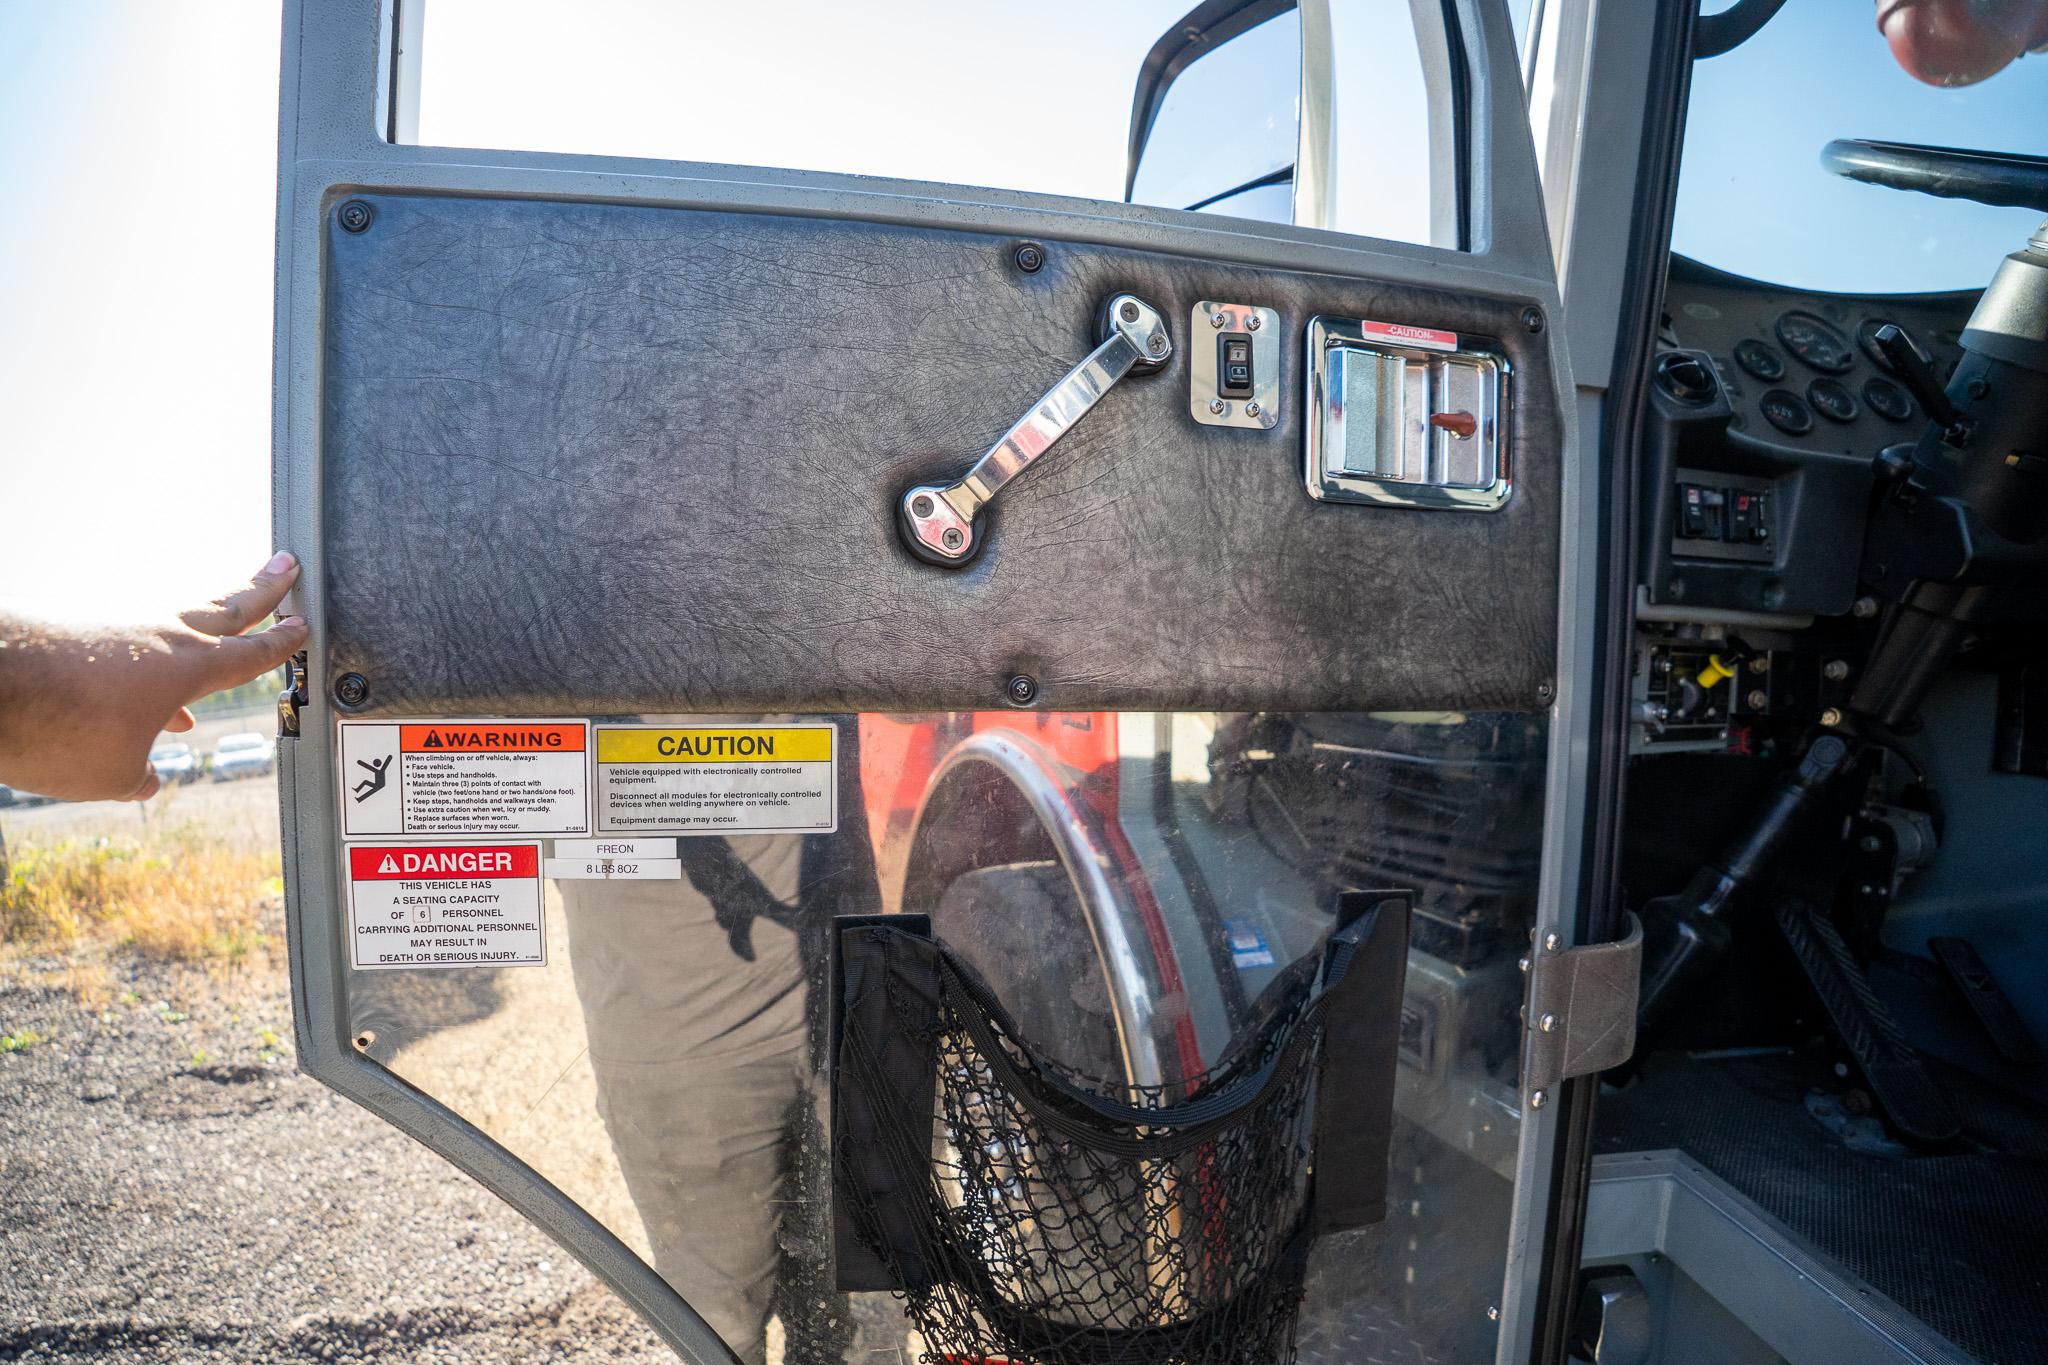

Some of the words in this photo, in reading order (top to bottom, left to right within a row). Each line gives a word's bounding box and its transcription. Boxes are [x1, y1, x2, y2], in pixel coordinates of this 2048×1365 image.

[445, 732, 562, 747] WARNING
[657, 736, 774, 756] CAUTION
[486, 754, 512, 762] vehicle,
[513, 754, 538, 762] always:
[609, 768, 641, 776] Vehicle
[641, 768, 681, 777] equipped
[703, 768, 759, 776] electronically
[760, 767, 802, 775] controlled
[460, 780, 470, 788] (3)
[471, 780, 492, 788] points
[609, 777, 657, 785] equipment.
[558, 788, 576, 796] foot).
[610, 792, 658, 800] Disconnect
[723, 791, 779, 800] electronically
[780, 791, 822, 800] controlled
[503, 797, 536, 805] walkways
[644, 800, 667, 808] when
[669, 800, 702, 809] welding
[704, 800, 744, 809] anywhere
[758, 798, 790, 806] vehicle.
[610, 816, 656, 825] Equipment
[657, 817, 691, 825] damage
[463, 823, 483, 831] injury
[596, 844, 634, 854] FREON
[403, 852, 513, 873] DANGER
[586, 864, 593, 874] 8
[595, 864, 615, 874] LBS
[399, 882, 423, 890] THIS
[424, 881, 468, 890] VEHICLE
[470, 880, 492, 889] HAS
[393, 897, 400, 905] A
[402, 896, 447, 905] SEATING
[449, 895, 500, 904] CAPACITY
[390, 911, 405, 920] OF
[420, 910, 426, 919] 6
[442, 909, 504, 918] PERSONNEL
[358, 925, 411, 934] CARRYING
[413, 924, 474, 933] ADDITIONAL
[476, 923, 538, 932] PERSONNEL
[410, 939, 432, 947] MAY
[435, 938, 475, 947] RESULT
[477, 938, 487, 946] IN
[379, 954, 414, 962] DEATH
[416, 953, 431, 962] OR
[434, 952, 478, 961] SERIOUS
[480, 951, 520, 961] INJURY.
